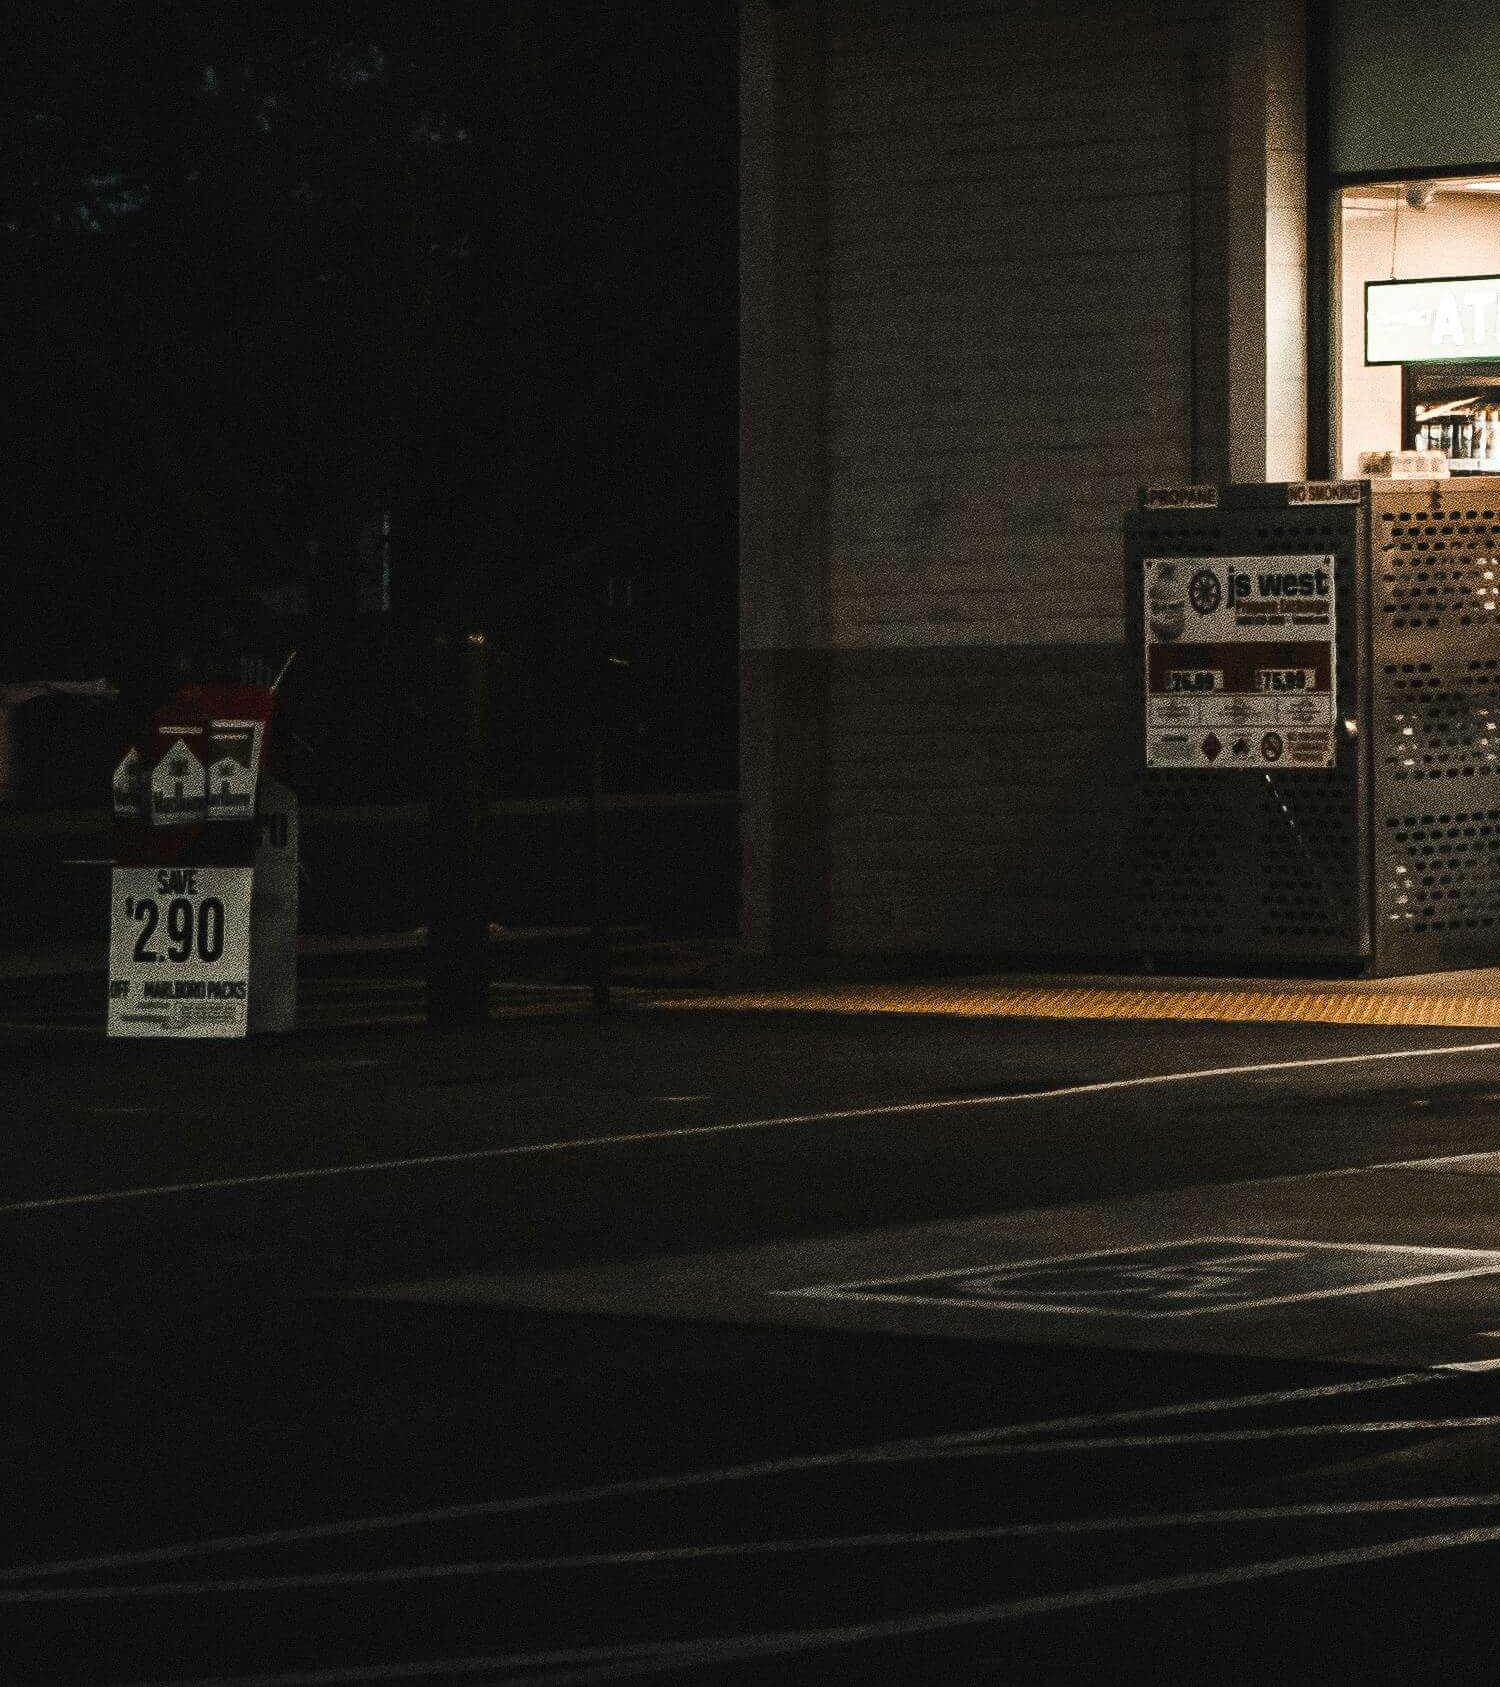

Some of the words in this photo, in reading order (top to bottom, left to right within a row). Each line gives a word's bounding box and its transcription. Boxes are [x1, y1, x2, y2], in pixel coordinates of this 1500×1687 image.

[1308, 485, 1360, 501] SMOKING
[1227, 565, 1251, 609] js
[1258, 568, 1329, 597] west
[157, 870, 197, 896] SAVE
